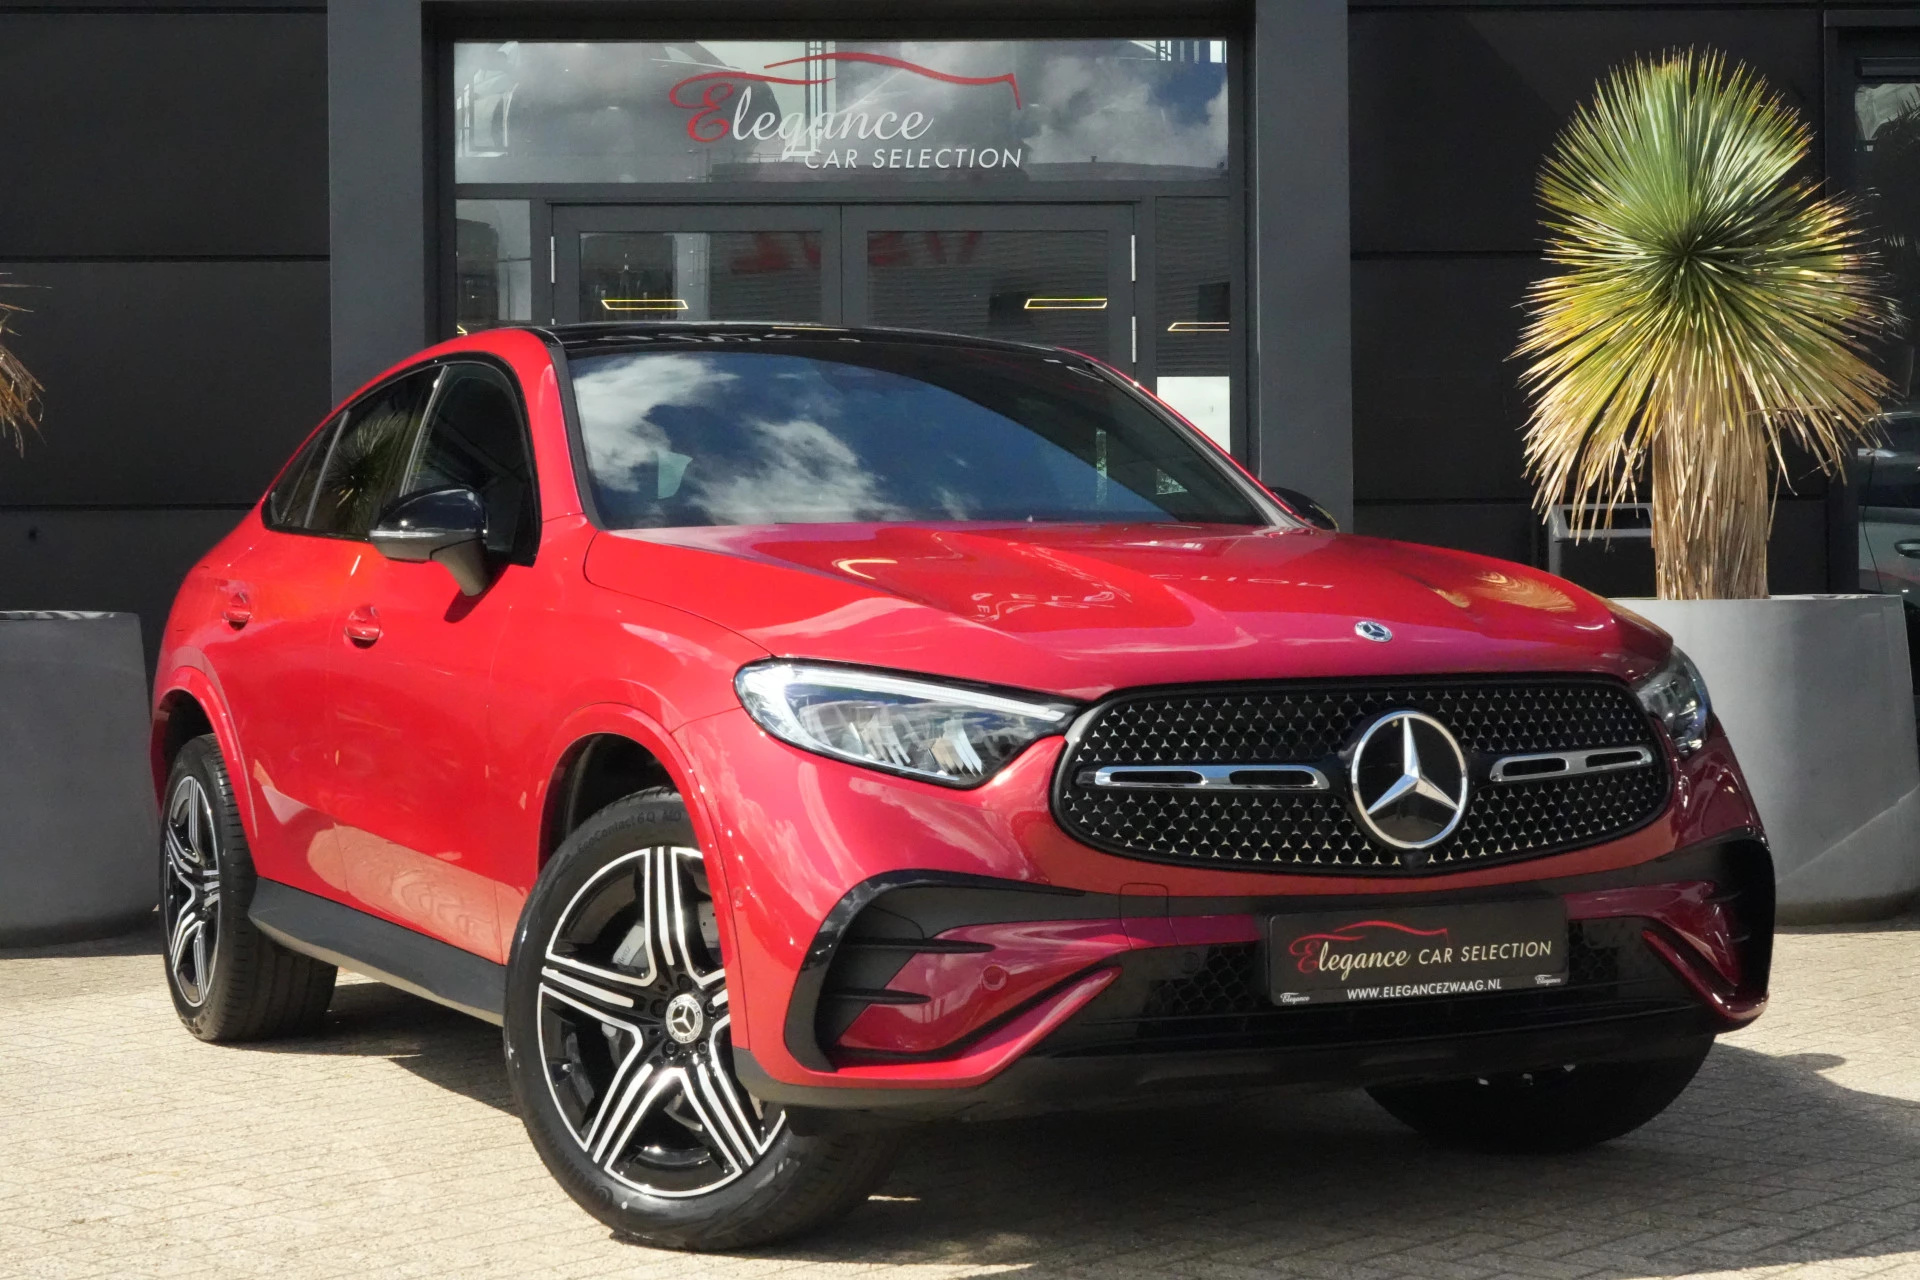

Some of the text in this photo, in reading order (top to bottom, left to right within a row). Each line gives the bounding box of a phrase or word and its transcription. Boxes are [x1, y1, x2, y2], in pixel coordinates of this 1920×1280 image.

[669, 71, 934, 162] Elegance
[804, 147, 1022, 169] CAR SELECTION
[1289, 934, 1552, 981] Elegance CAR SELECTION
[1346, 978, 1502, 1000] WWW.ELEGANCEZWAAG.NL
